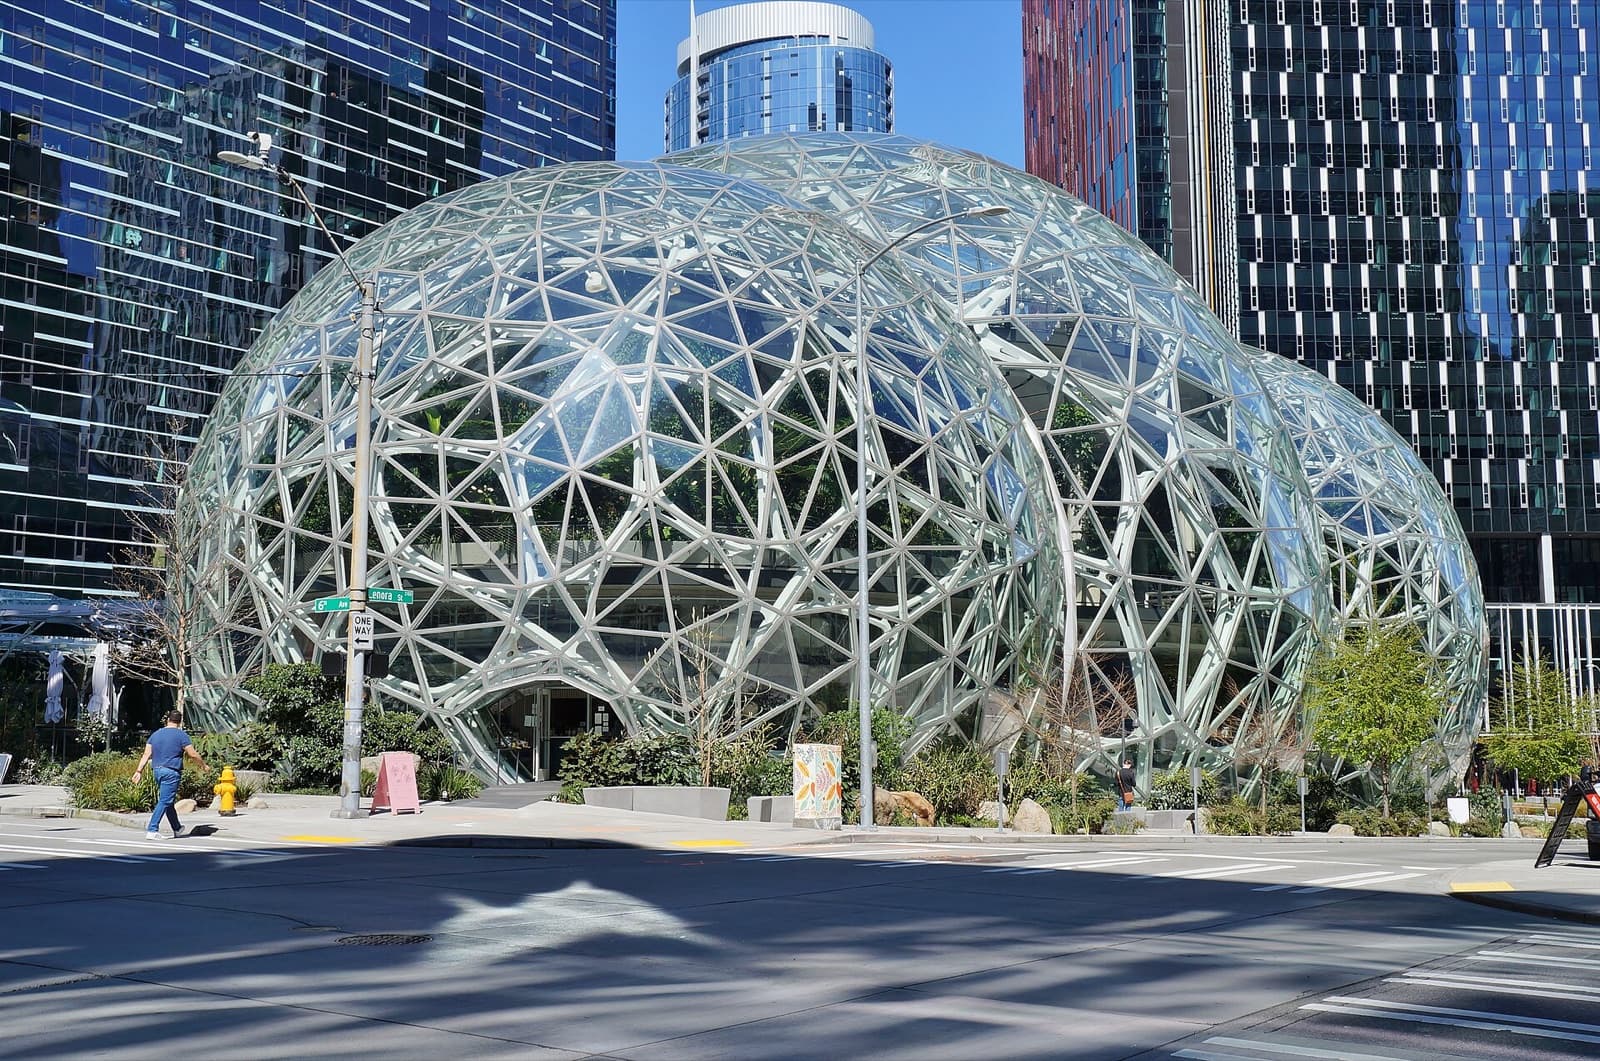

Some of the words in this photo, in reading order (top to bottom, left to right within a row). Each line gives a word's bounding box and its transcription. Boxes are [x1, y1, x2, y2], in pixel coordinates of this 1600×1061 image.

[397, 593, 403, 602] St
[354, 616, 371, 625] ONE
[354, 626, 371, 635] WAY
[35, 670, 49, 680] 21
